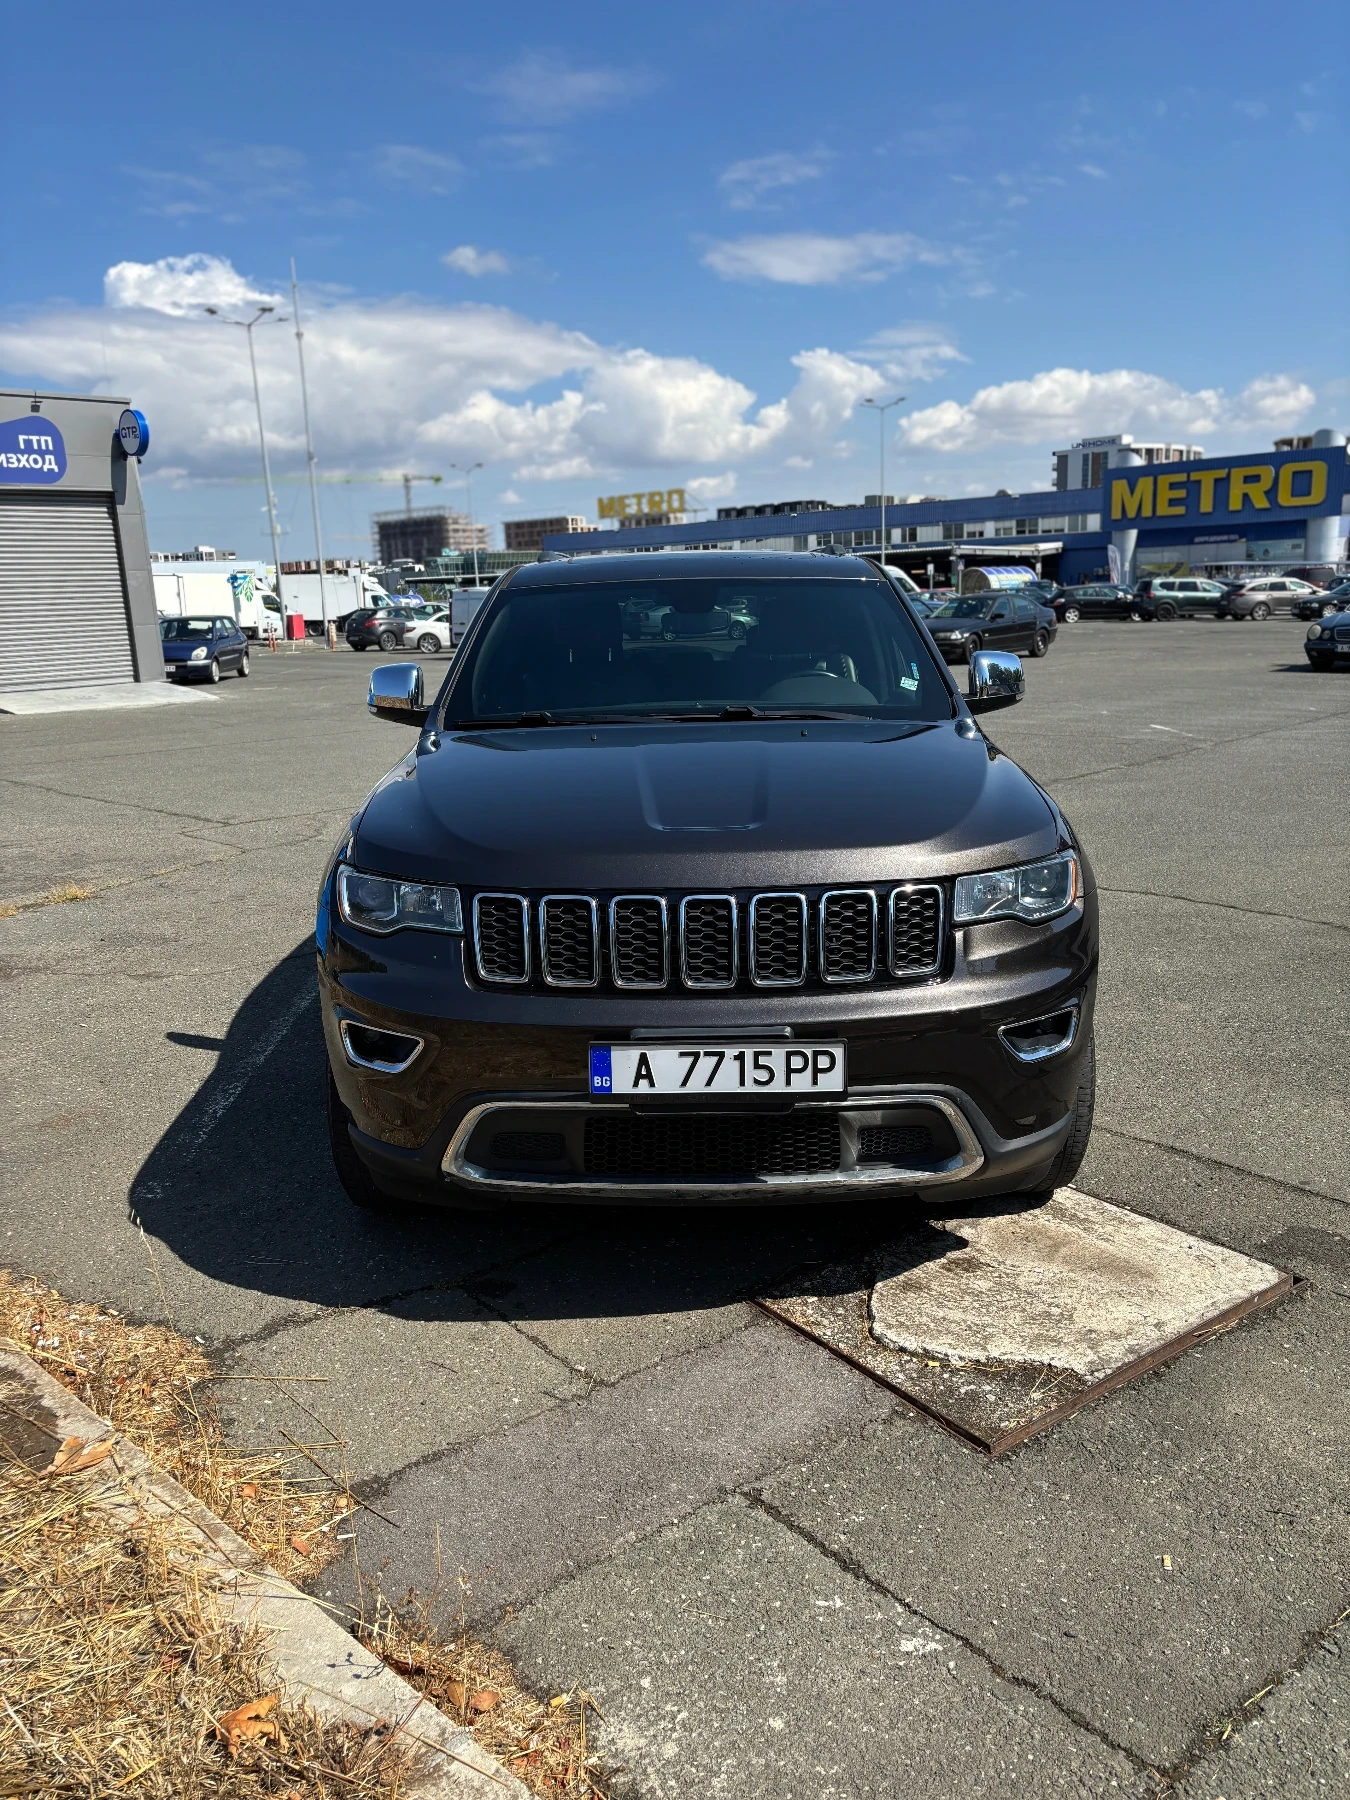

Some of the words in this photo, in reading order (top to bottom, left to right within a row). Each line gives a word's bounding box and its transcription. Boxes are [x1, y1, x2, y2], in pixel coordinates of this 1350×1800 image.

[120, 426, 137, 439] GTP
[18, 434, 53, 450] ГТП
[1071, 438, 1117, 449] UNIHOME
[1111, 460, 1329, 521] METRO
[597, 488, 685, 519] METRO
[631, 1051, 657, 1088] A
[593, 1076, 611, 1087] BG
